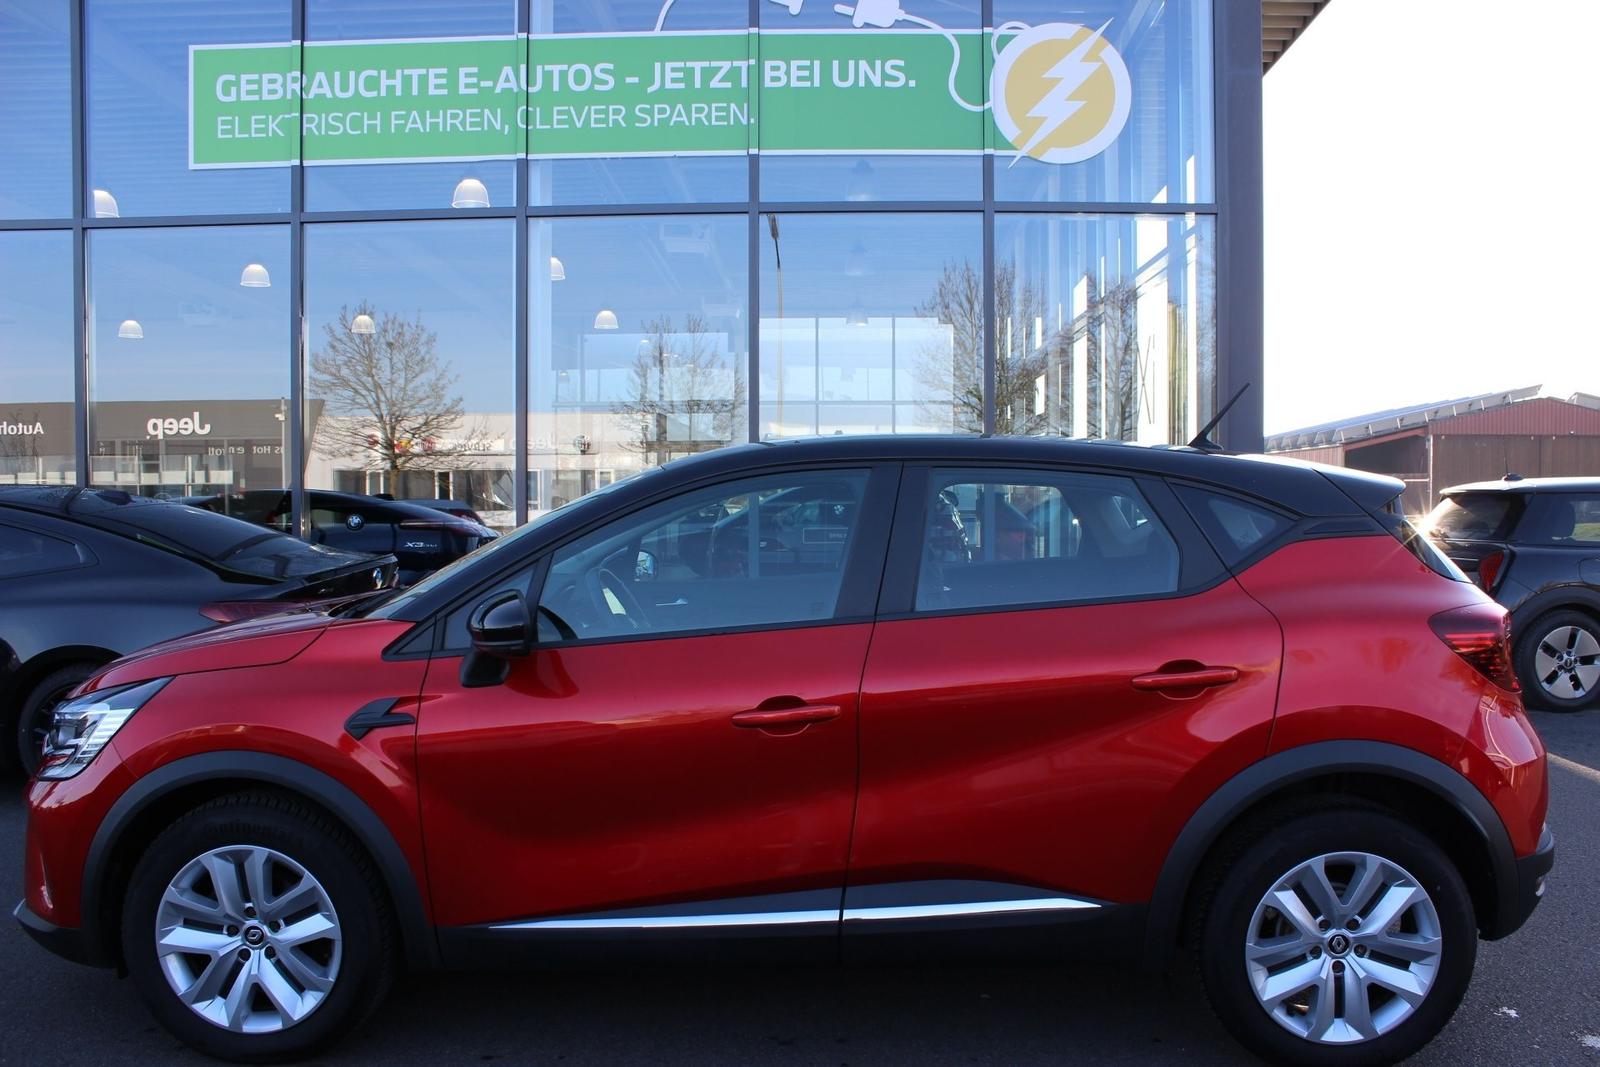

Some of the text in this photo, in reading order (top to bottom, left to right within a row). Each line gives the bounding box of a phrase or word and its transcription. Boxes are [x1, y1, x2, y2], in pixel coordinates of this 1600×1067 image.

[215, 67, 449, 103] GEBRAUCHTE
[457, 62, 616, 96] E-AUTOS
[646, 59, 756, 95] JETZT
[763, 59, 821, 89] BEI
[831, 58, 917, 89] UNS.
[390, 107, 511, 136] FAHREN,
[517, 104, 627, 130] CLEVER
[634, 101, 756, 128] SPAREN.
